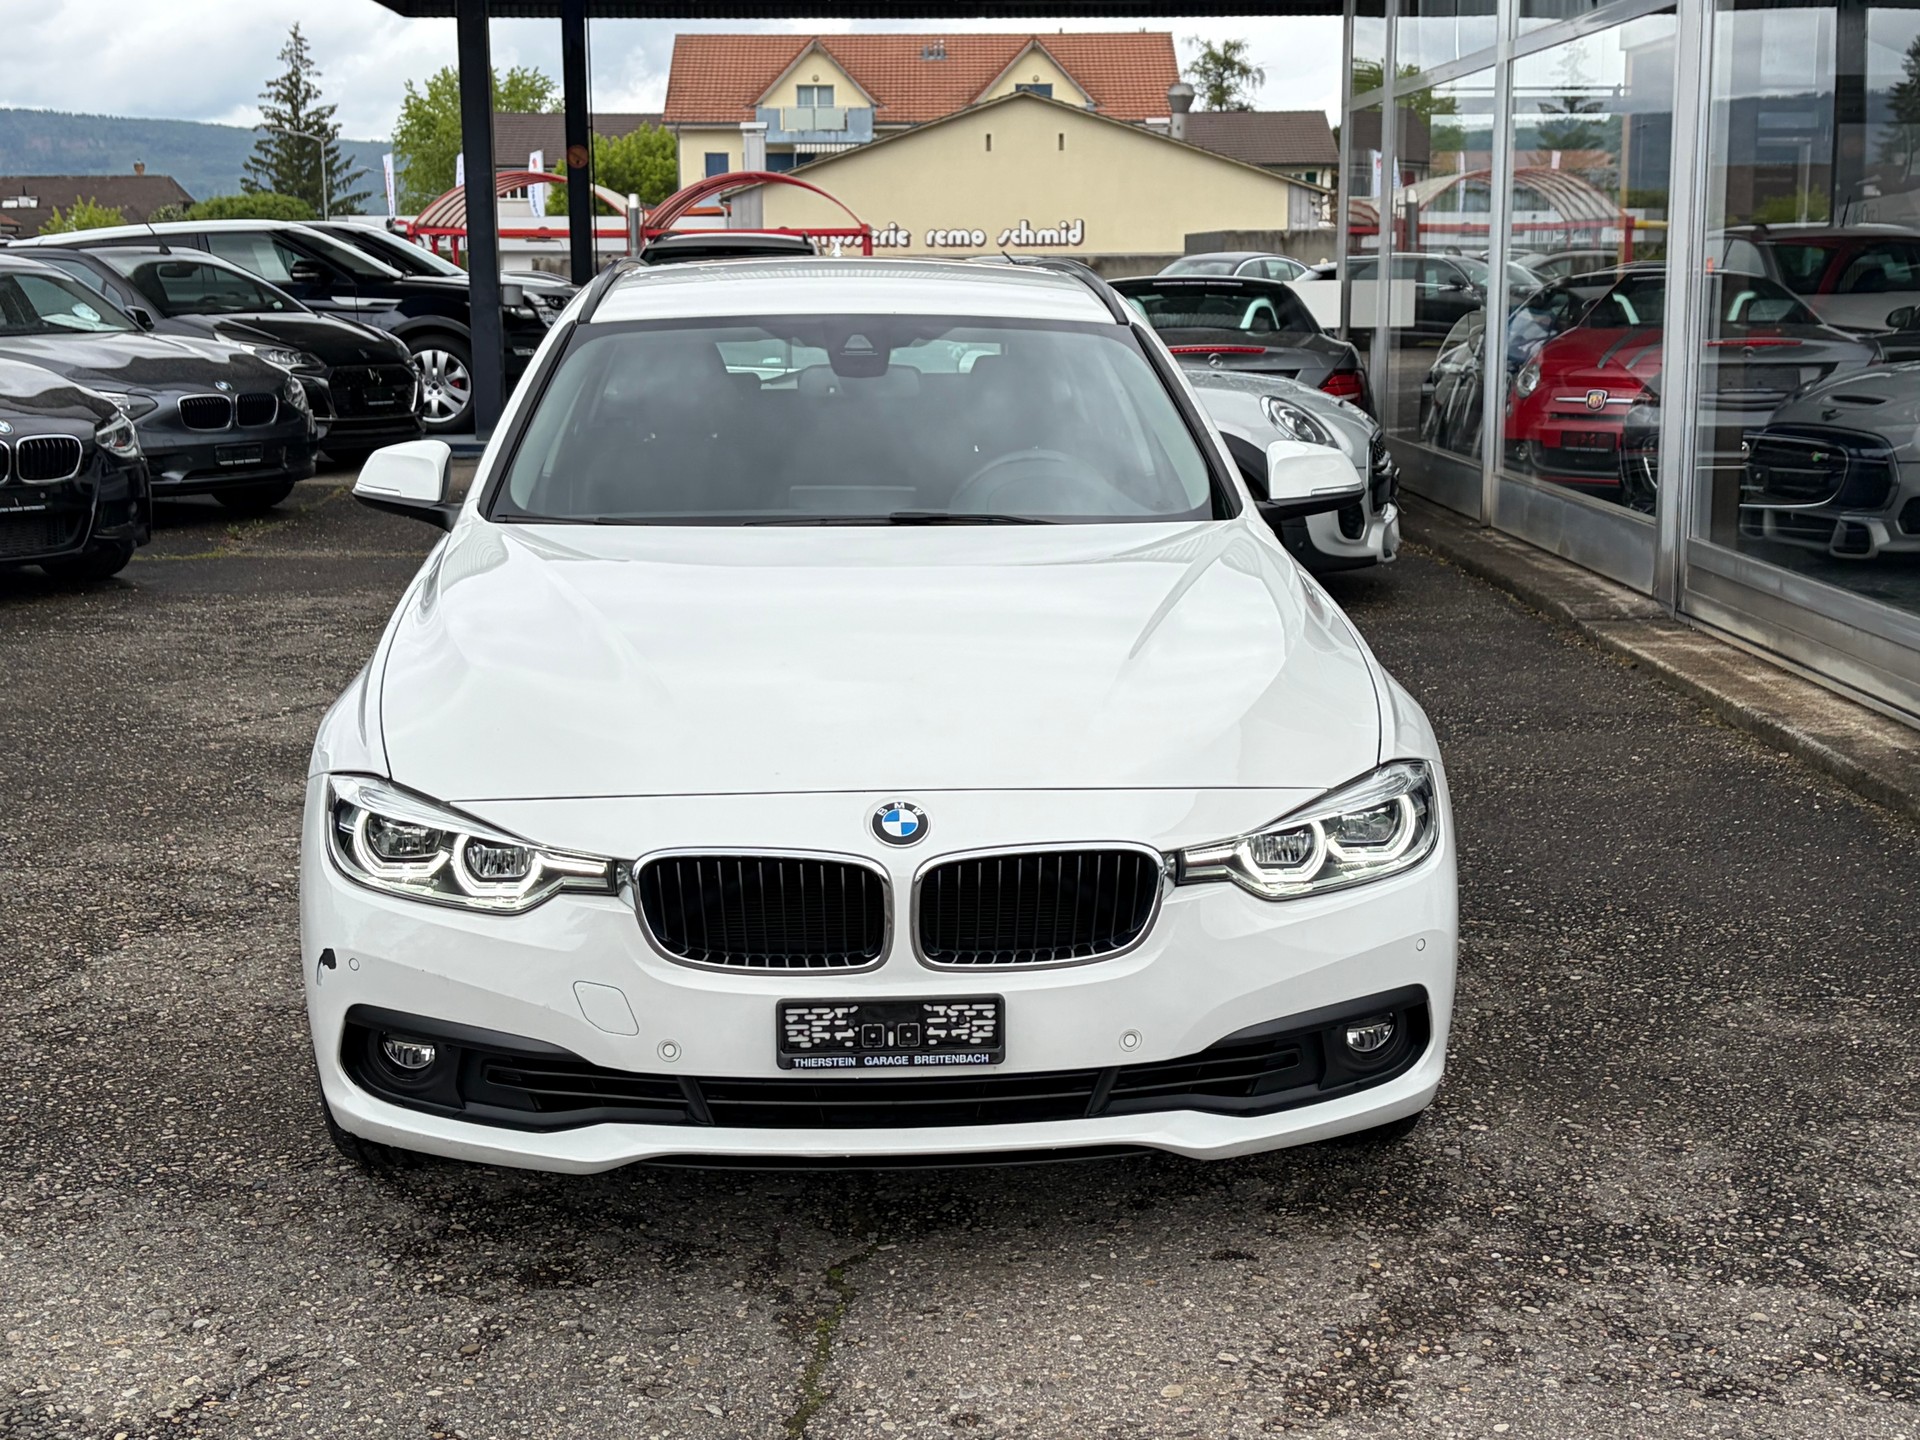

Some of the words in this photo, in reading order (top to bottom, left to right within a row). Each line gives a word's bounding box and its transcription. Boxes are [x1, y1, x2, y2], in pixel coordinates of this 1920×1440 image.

[926, 229, 986, 247] remo
[997, 219, 1084, 247] schmid
[876, 801, 924, 816] BMW
[793, 1057, 856, 1067] THIERSTEIN
[864, 1056, 909, 1066] GARAGE
[914, 1054, 990, 1065] BREITENBACH
